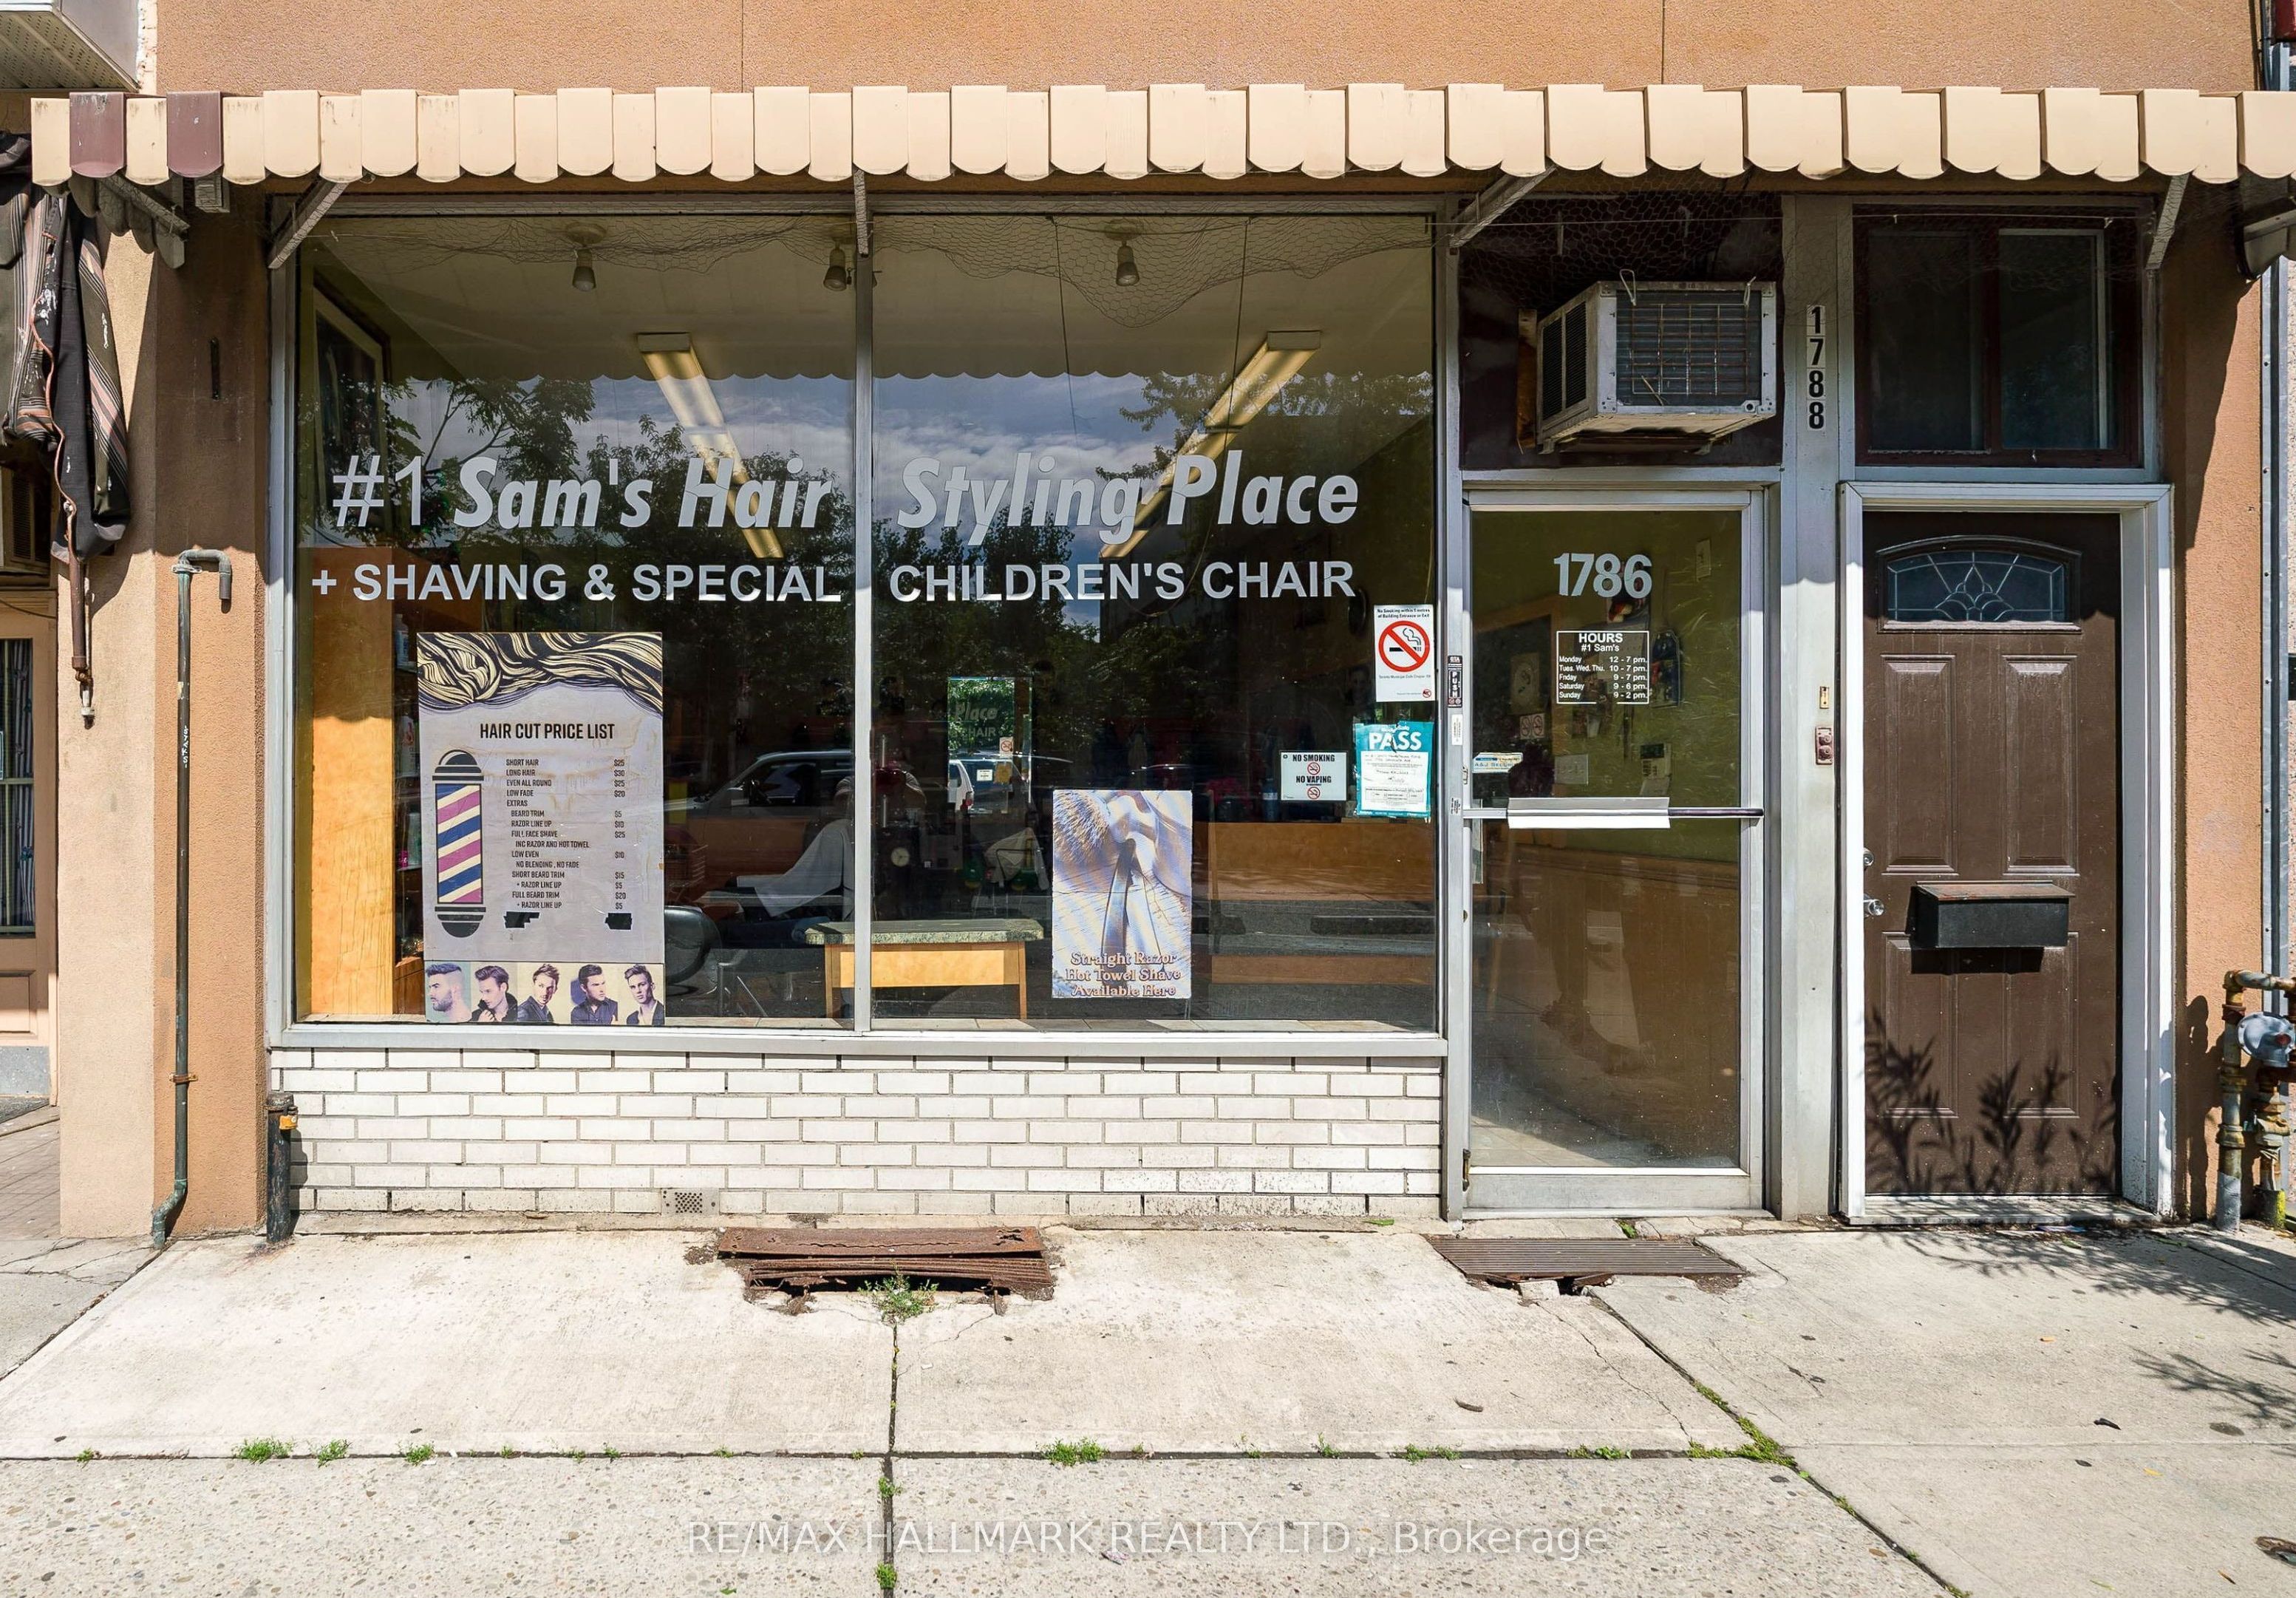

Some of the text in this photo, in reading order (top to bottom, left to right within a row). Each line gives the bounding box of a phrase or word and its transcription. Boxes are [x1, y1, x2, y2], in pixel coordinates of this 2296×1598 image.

[1809, 306, 1825, 429] 1788
[333, 449, 1359, 547] #1 Sam's Hair Styling Place
[352, 564, 565, 602] SHAVING
[585, 564, 617, 602] &
[632, 564, 842, 602] SPECIAL
[890, 562, 1185, 602] CHILDREN'S
[1202, 561, 1356, 599] CHAIR
[1553, 552, 1652, 598] 1786
[1578, 633, 1623, 643] HOURS
[1559, 656, 1582, 664] Monday
[1559, 682, 1584, 690] Saturday
[1559, 691, 1581, 699] Sunday
[955, 701, 998, 721] Place
[480, 724, 615, 739] HAIR CUT PRICE LIST
[1369, 731, 1422, 750] PASS
[1292, 754, 1335, 762] NO SMOKING
[615, 810, 622, 818] $5
[1071, 951, 1177, 968] Straight Razor
[1066, 968, 1181, 981] Hot Towel Shave
[1071, 985, 1176, 996] Available Here
